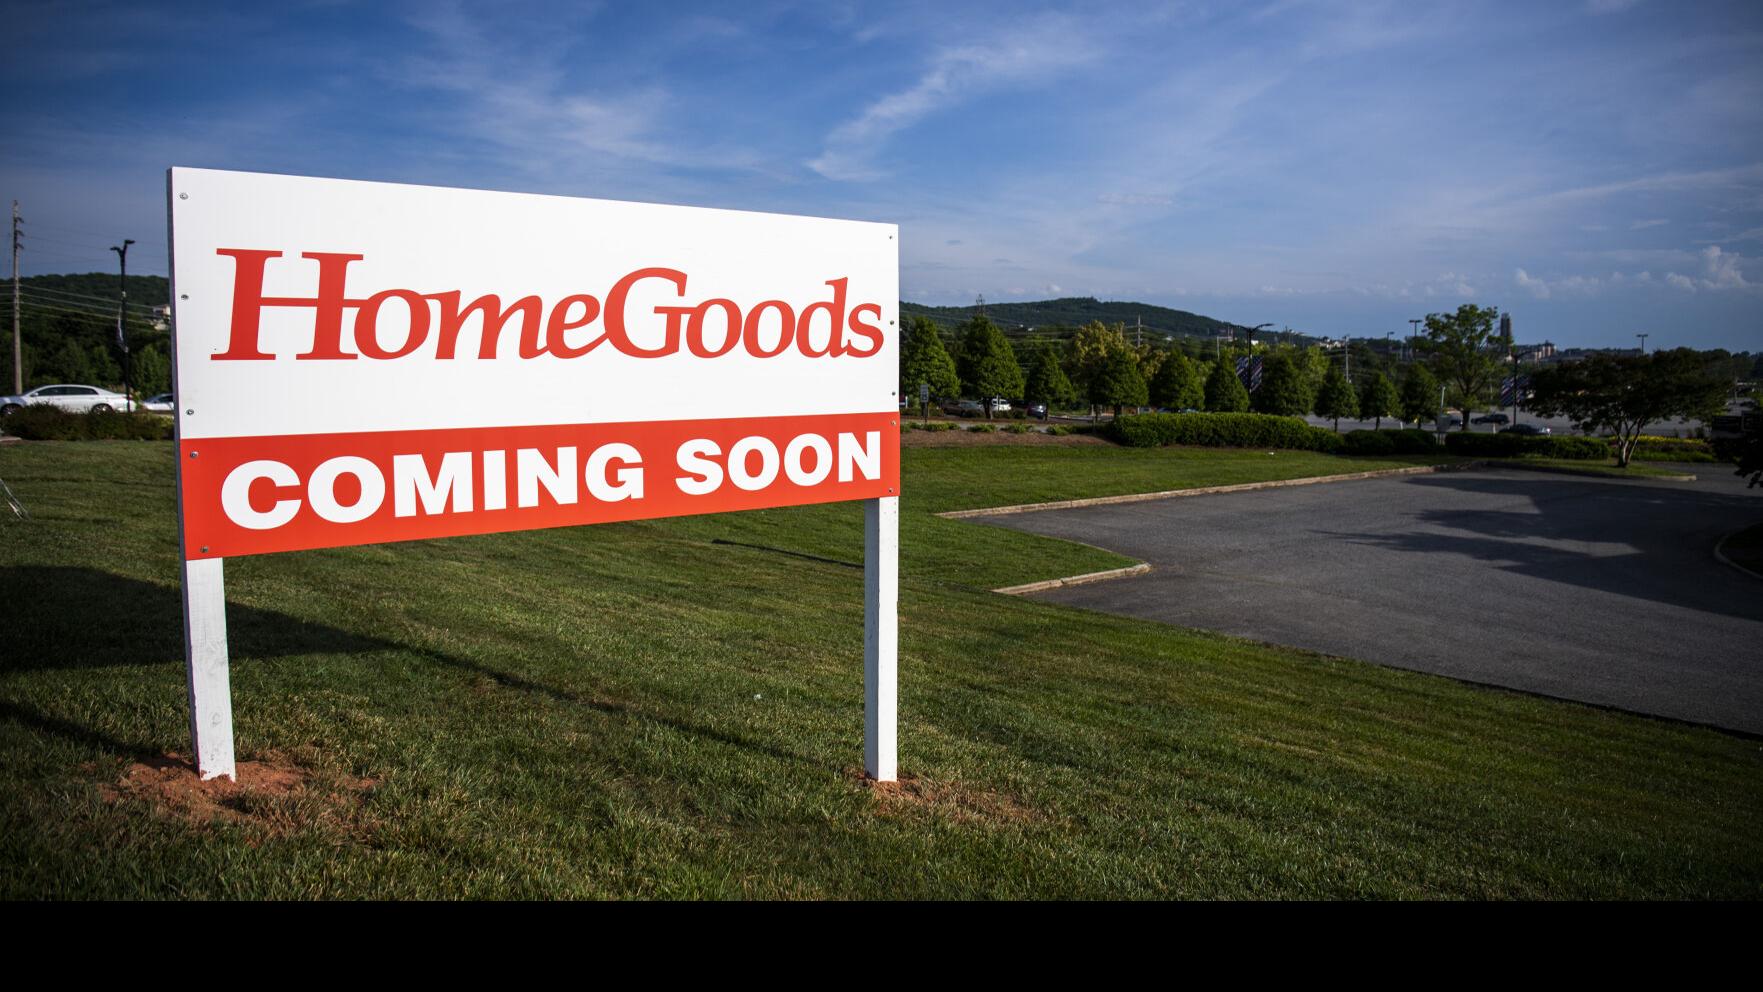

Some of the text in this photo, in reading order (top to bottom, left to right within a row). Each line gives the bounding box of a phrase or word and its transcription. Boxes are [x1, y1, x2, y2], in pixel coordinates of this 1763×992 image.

[211, 248, 883, 361] HomeGoods
[221, 431, 882, 530] COMING SOON
